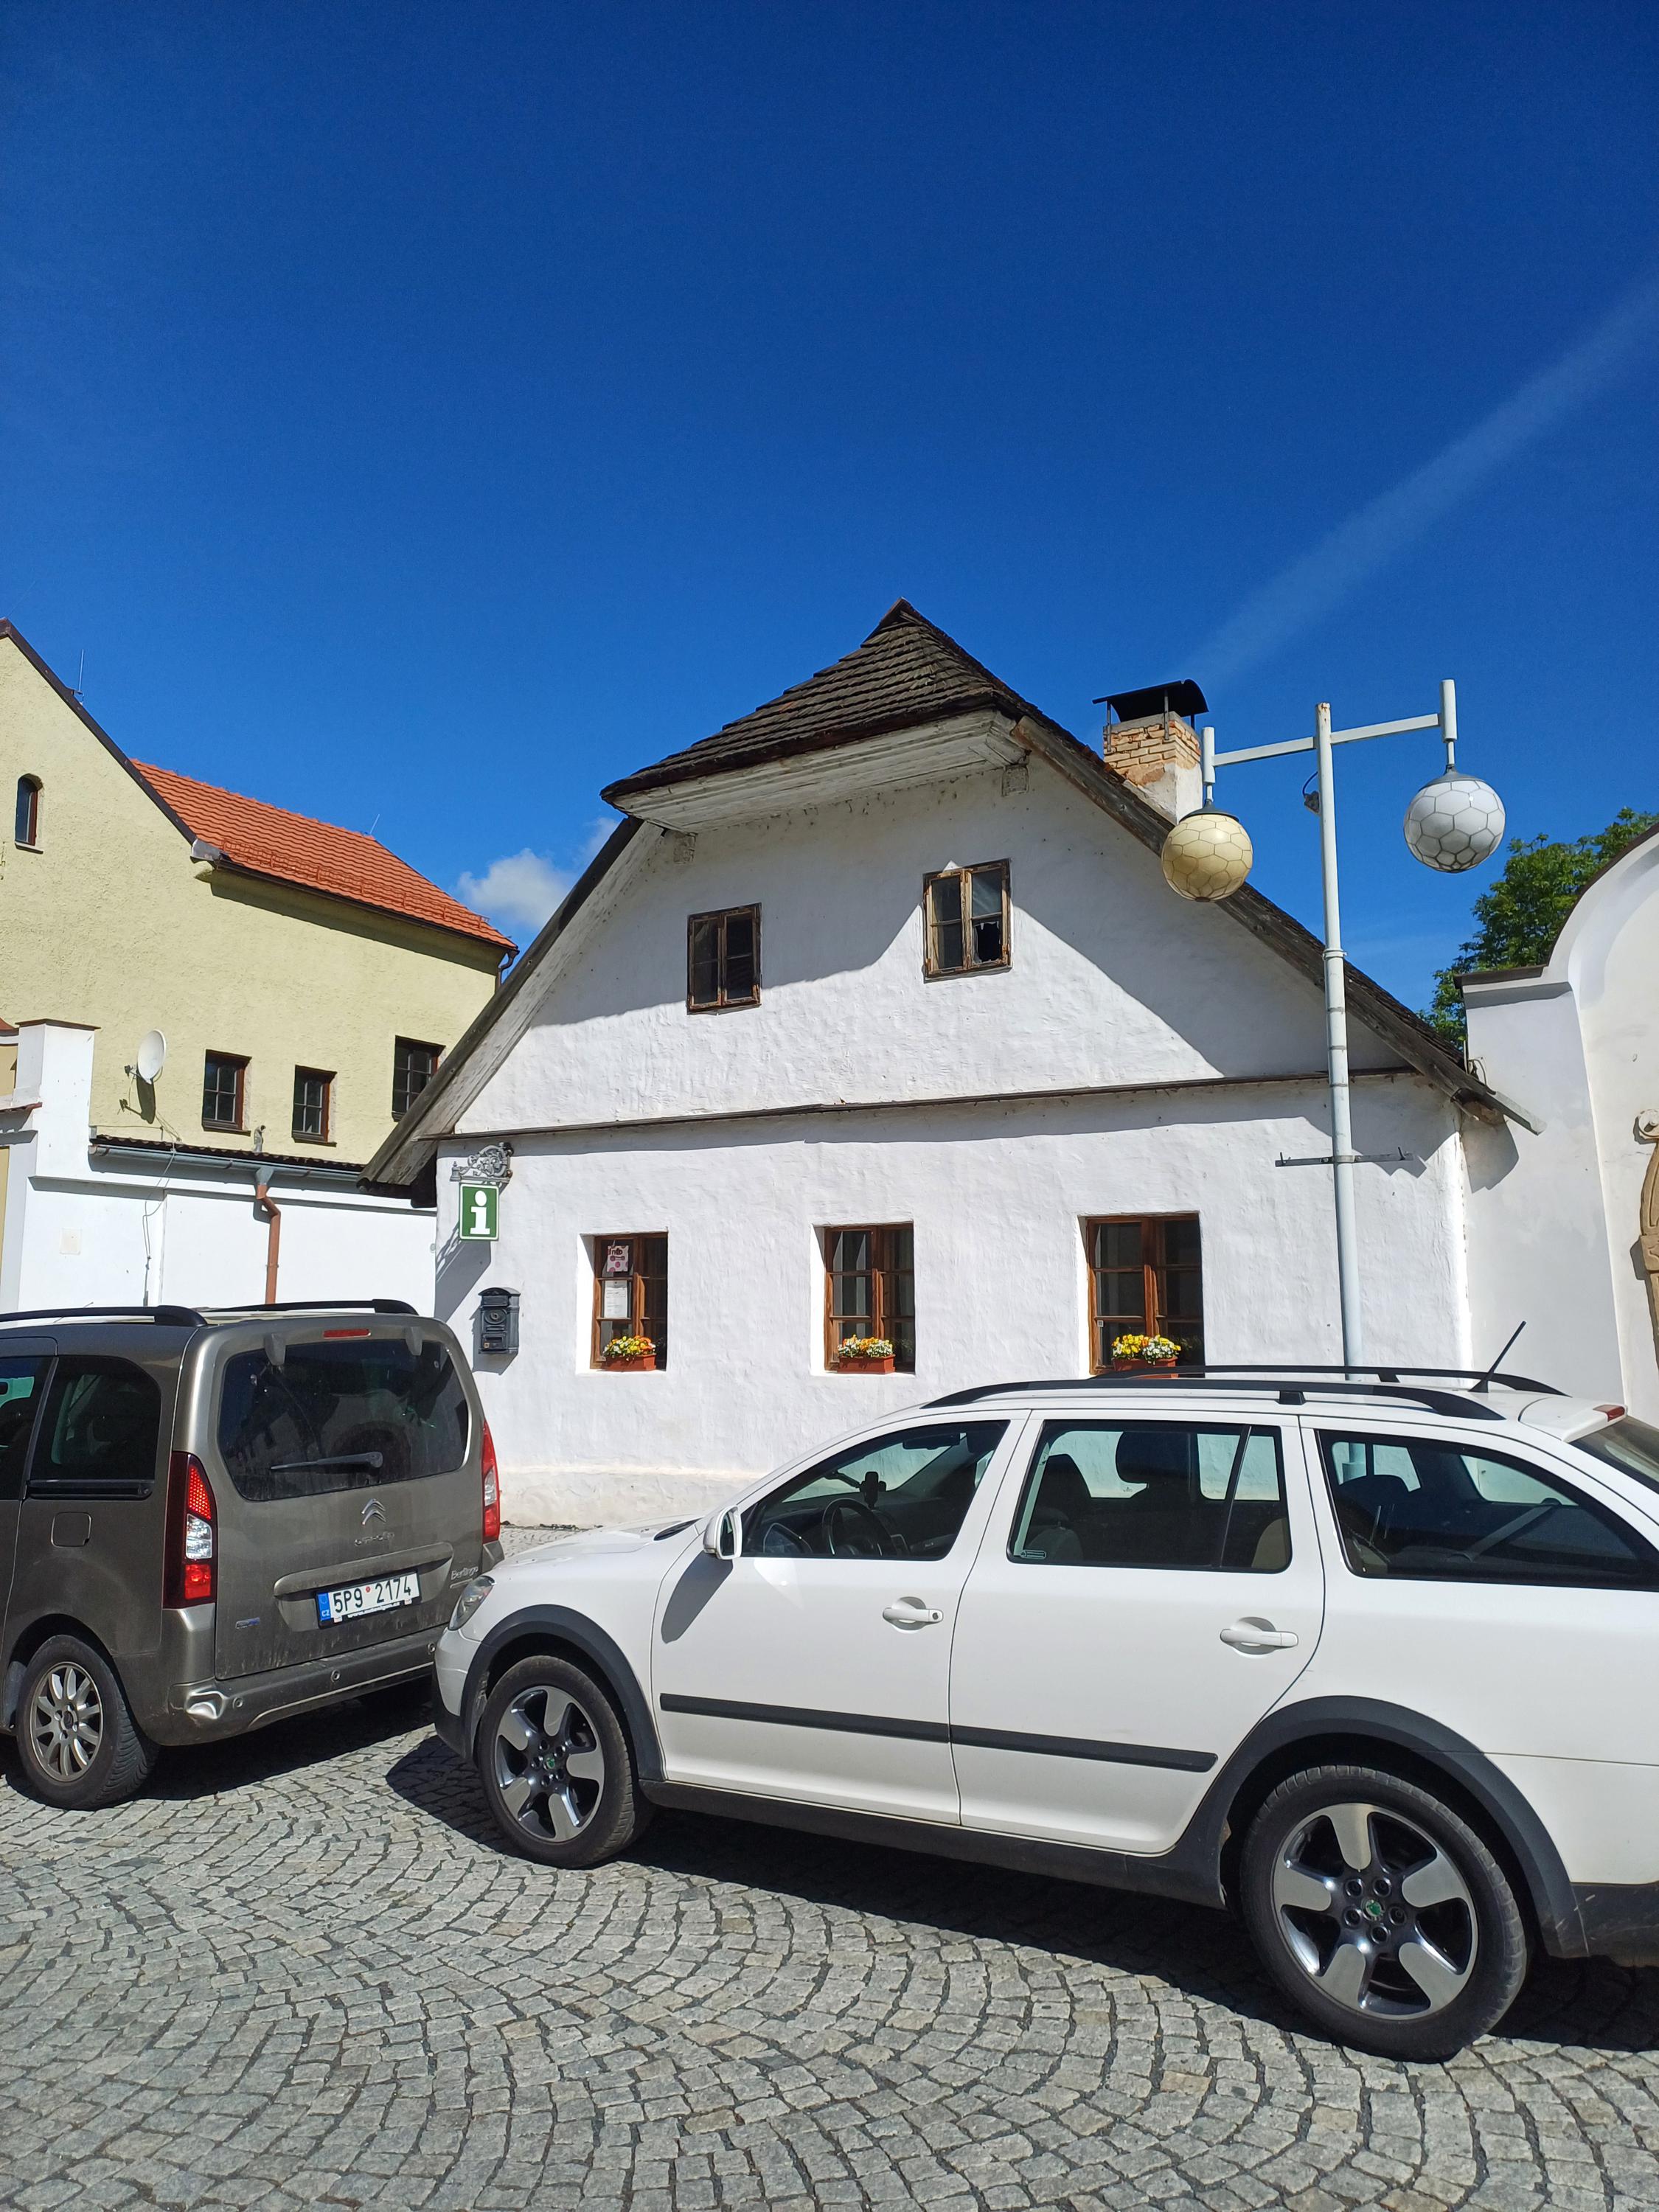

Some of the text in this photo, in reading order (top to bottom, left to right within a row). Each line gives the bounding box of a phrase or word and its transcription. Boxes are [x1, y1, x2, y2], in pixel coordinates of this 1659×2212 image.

[470, 1190, 490, 1235] i
[333, 1587, 364, 1613] 5P9
[375, 1576, 411, 1604] 2174
[321, 1609, 330, 1618] CZ
